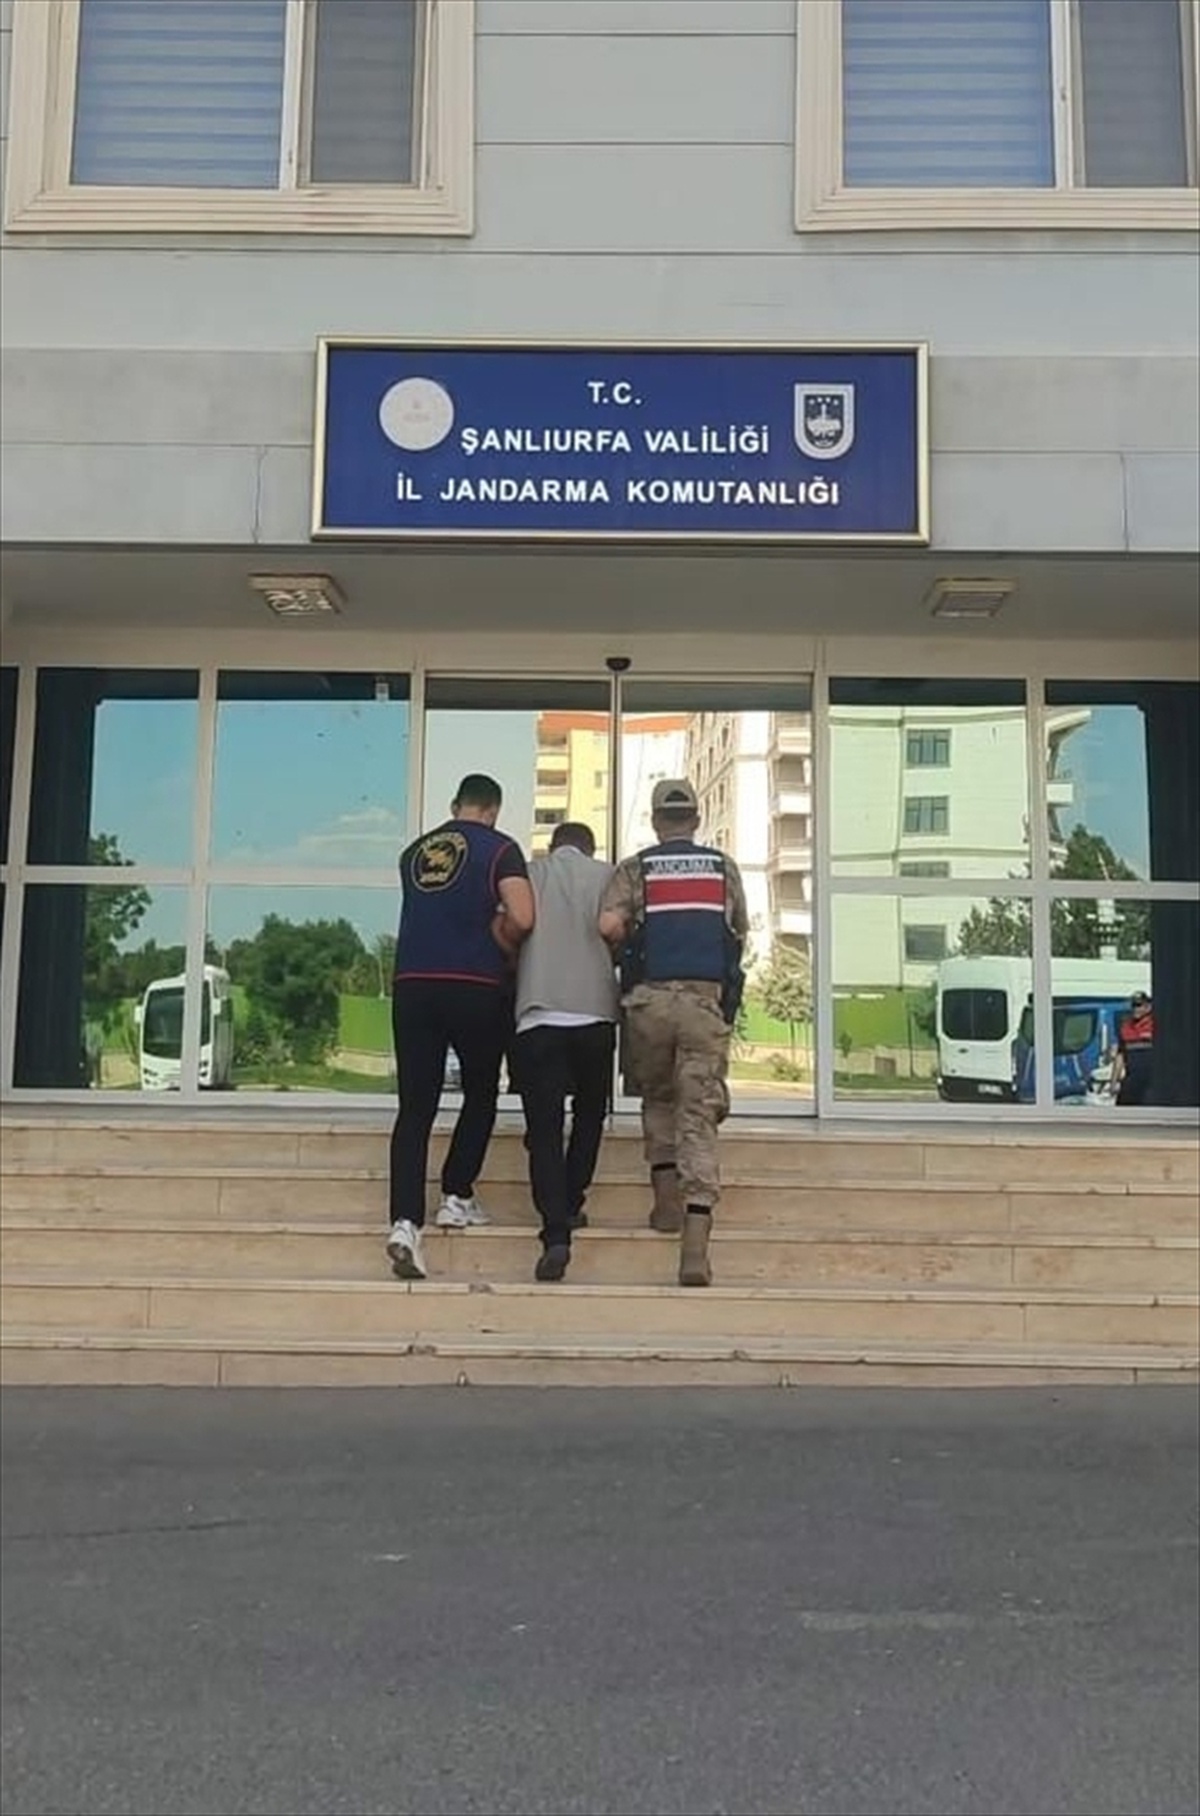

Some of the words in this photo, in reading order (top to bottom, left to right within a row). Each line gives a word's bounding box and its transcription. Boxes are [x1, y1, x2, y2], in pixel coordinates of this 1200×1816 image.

[587, 381, 642, 404] T.C.
[460, 427, 632, 455] ŞANLIURFA
[644, 425, 769, 453] VALİLİĞİ
[396, 472, 422, 500] İL
[440, 478, 610, 502] JANDARMA
[627, 475, 839, 505] KOMUTANLIĞI
